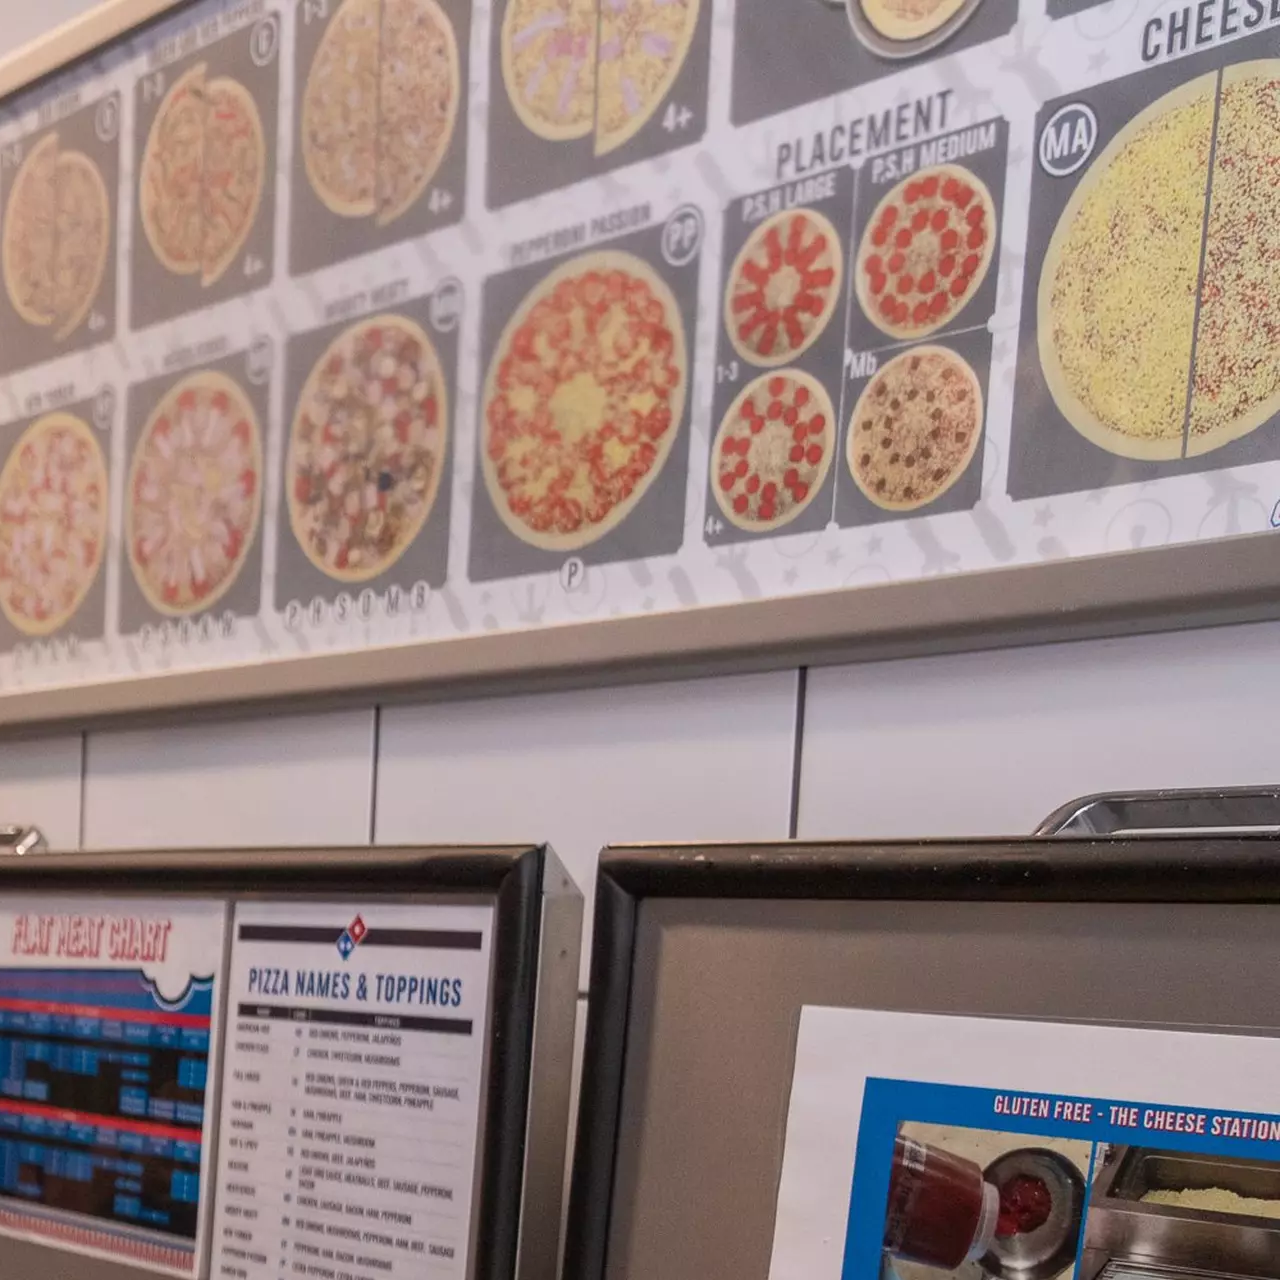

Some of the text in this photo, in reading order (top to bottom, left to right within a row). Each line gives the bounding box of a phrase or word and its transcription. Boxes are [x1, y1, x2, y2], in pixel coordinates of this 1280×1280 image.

[777, 89, 953, 180] PLACEMENT
[918, 123, 996, 170] MEDIUM
[1046, 117, 1088, 161] MA
[785, 173, 837, 207] LARGE
[590, 200, 651, 237] PASSION
[850, 352, 878, 380] Mb
[12, 914, 172, 964] FLAT MEAT CHART
[249, 968, 462, 1008] PIZZA NAMES & TOPPINGS
[994, 1095, 1049, 1117] GLUTEN
[1054, 1101, 1091, 1122] FREE
[1110, 1106, 1137, 1126] THE
[1144, 1110, 1206, 1134] CHEESE
[1211, 1116, 1280, 1140] STATION
